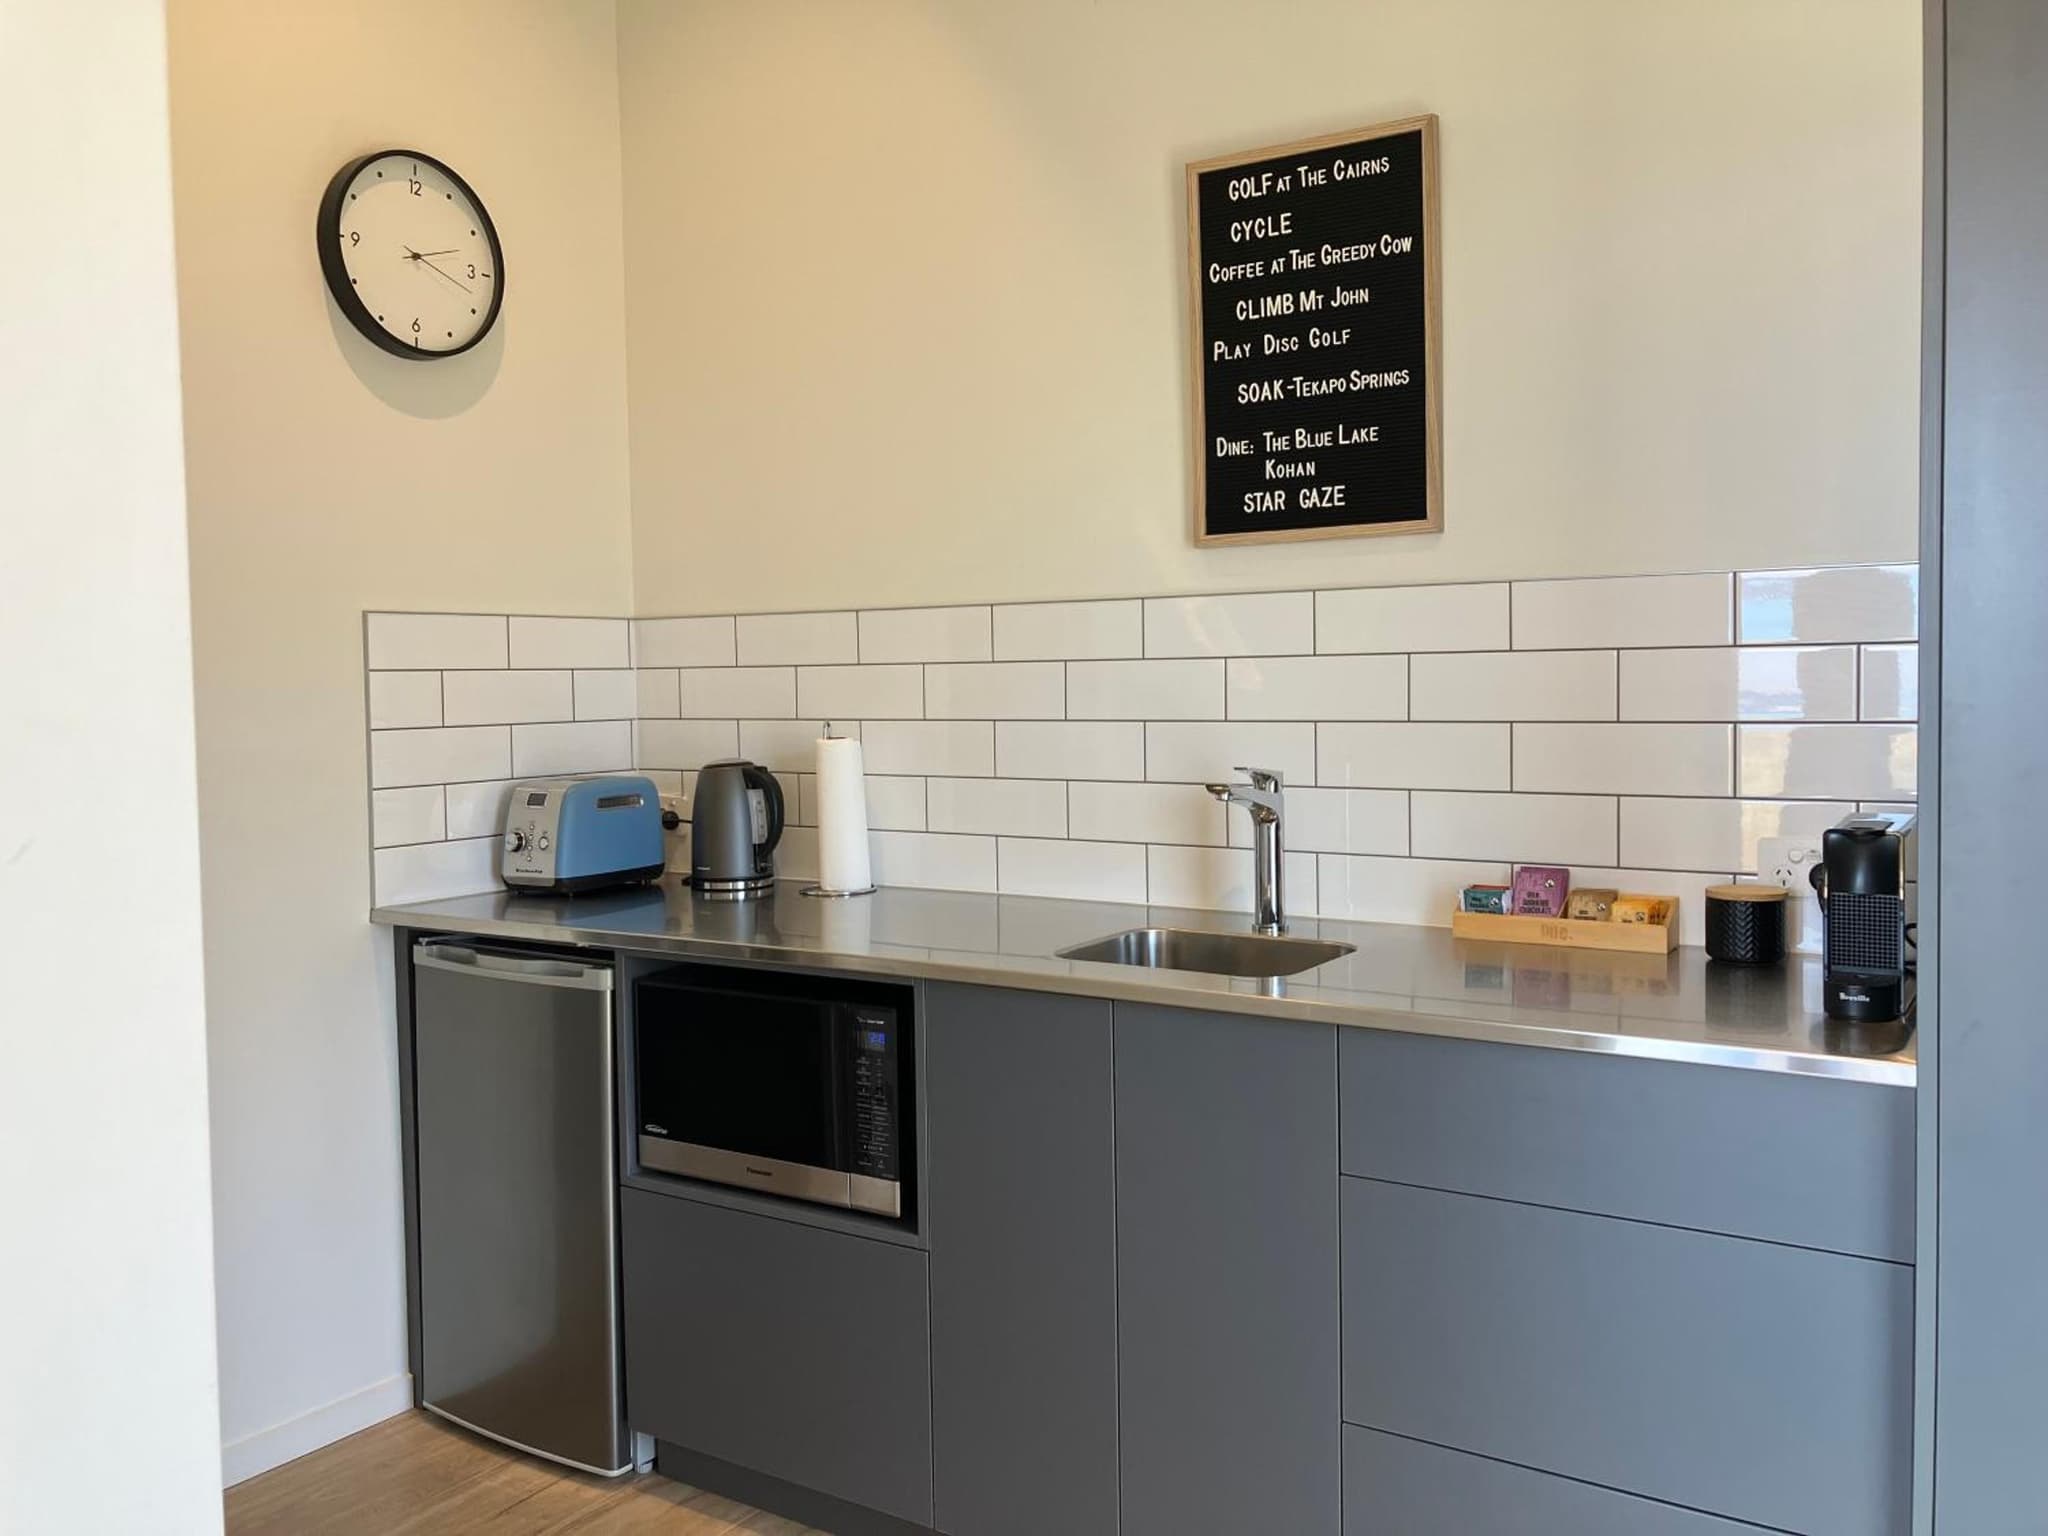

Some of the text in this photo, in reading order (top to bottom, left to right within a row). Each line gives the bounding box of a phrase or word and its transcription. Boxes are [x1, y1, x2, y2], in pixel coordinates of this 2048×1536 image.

[408, 178, 423, 197] 12
[1228, 157, 1390, 201] GOLF AT THE CAIRNS
[350, 231, 361, 247] 9
[1230, 213, 1293, 243] CYCLE
[467, 264, 476, 280] 3
[1209, 234, 1413, 284] COFFEE AT THE GREEDY COW
[1235, 285, 1369, 321] CLIMB MT JOHN
[411, 317, 421, 333] 6
[1213, 327, 1351, 362] PLAY DISC GOLF
[1349, 369, 1410, 391] SPRINGS
[1216, 423, 1379, 457] DINE: THE BLUE LAKE
[1265, 459, 1315, 480] KOHAN
[1243, 485, 1346, 513] STAR GAZE
